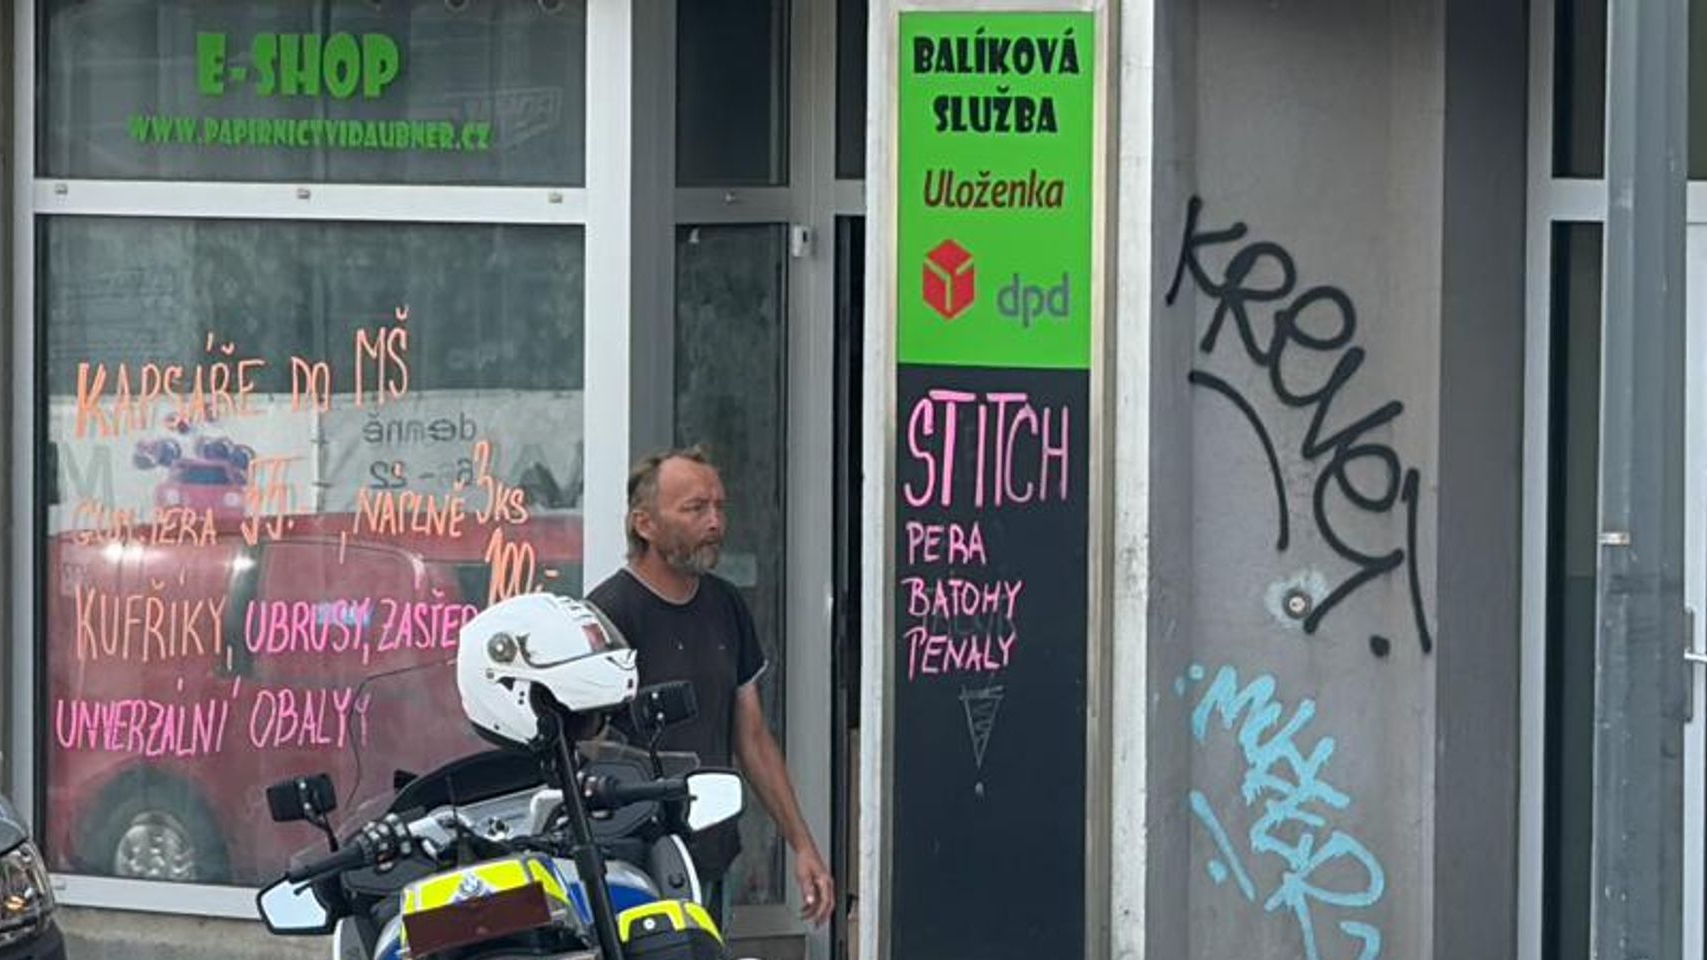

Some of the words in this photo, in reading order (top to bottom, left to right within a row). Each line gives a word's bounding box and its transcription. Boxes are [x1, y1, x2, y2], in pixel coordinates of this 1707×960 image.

[196, 31, 400, 98] E-SHOP
[912, 27, 1080, 75] BALÍKOVÁ
[127, 114, 492, 151] WWW.PAPIRNICTVIDAUBNER.CZ
[933, 85, 1058, 133] SLUŽBA
[924, 168, 1065, 209] Uloženka
[997, 272, 1069, 329] dpd
[76, 332, 266, 438] KAPSÁŘE
[290, 356, 330, 412] DO
[355, 305, 409, 409] MŠ
[903, 389, 1070, 508] STITCH
[906, 520, 987, 565] PERA
[900, 577, 1023, 619] BATOHY
[244, 597, 369, 666] UBRUSY,
[903, 626, 1017, 680] PENALY
